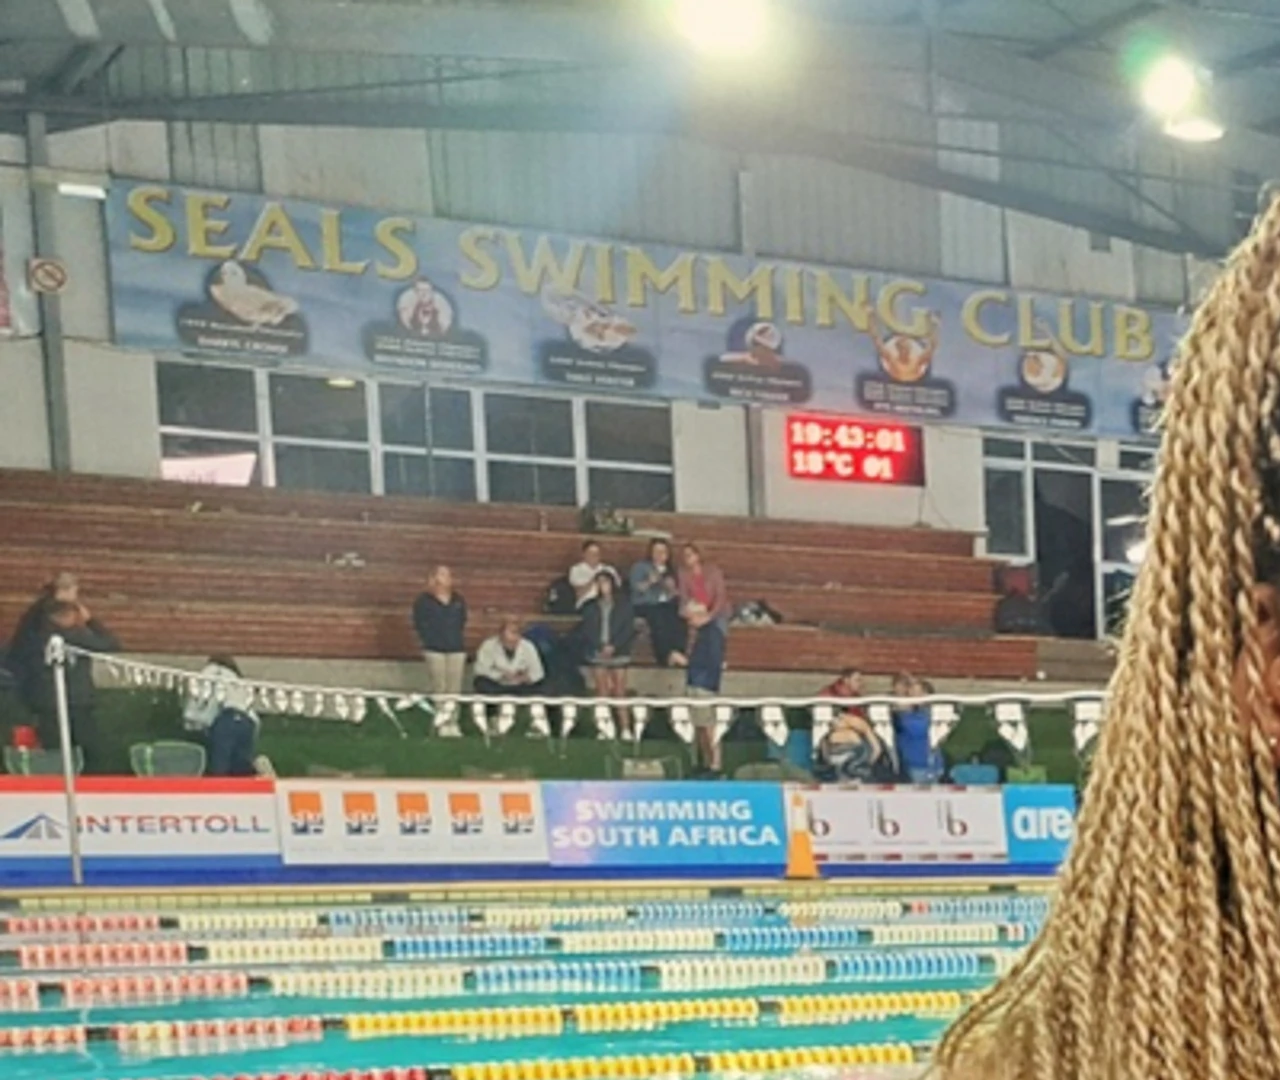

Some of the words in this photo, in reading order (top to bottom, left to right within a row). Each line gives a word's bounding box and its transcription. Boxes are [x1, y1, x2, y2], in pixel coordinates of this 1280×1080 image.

[126, 185, 419, 280] SEALS
[457, 224, 936, 338] SWIMMING
[961, 289, 1156, 361] CLUB
[574, 800, 754, 822] SWIMMING
[76, 814, 271, 834] INTERTOLL
[1012, 806, 1073, 841] are
[552, 825, 660, 848] SOUTH
[668, 825, 780, 846] AFRICA
